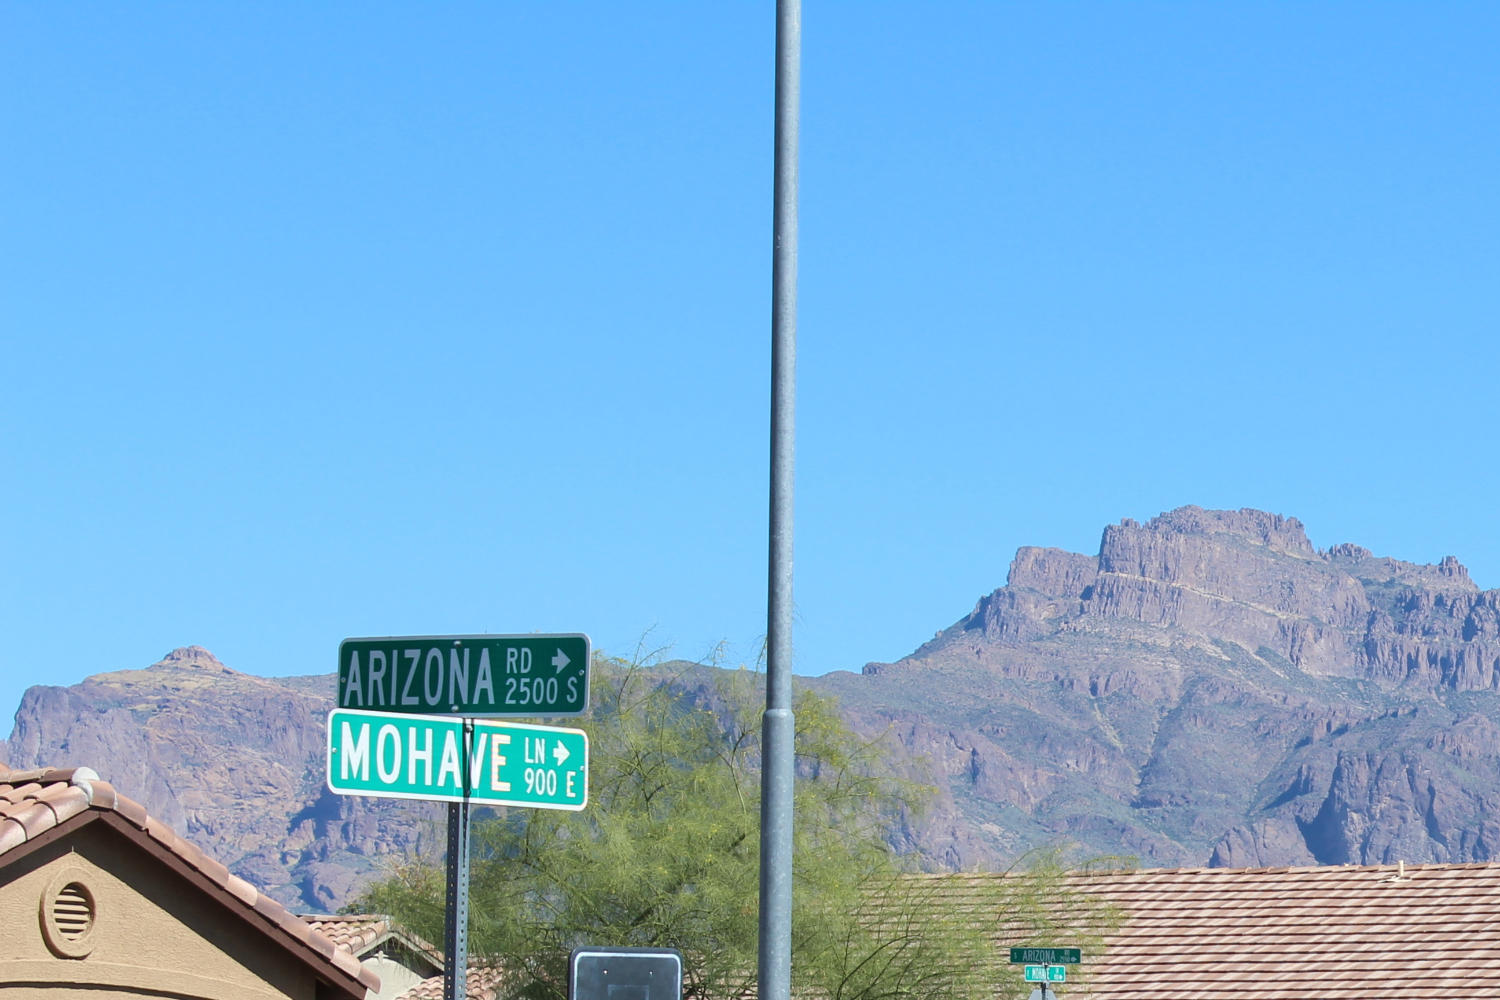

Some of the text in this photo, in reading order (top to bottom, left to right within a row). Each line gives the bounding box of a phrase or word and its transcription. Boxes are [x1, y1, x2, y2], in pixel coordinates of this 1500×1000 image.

[343, 647, 532, 706] ARIZONA RD
[505, 676, 578, 705] 2500 S
[340, 721, 546, 792] MOHAVE LN
[524, 767, 577, 798] 900 E
[1022, 949, 1056, 962] ARIZONA
[1032, 967, 1050, 980] MOHAE
